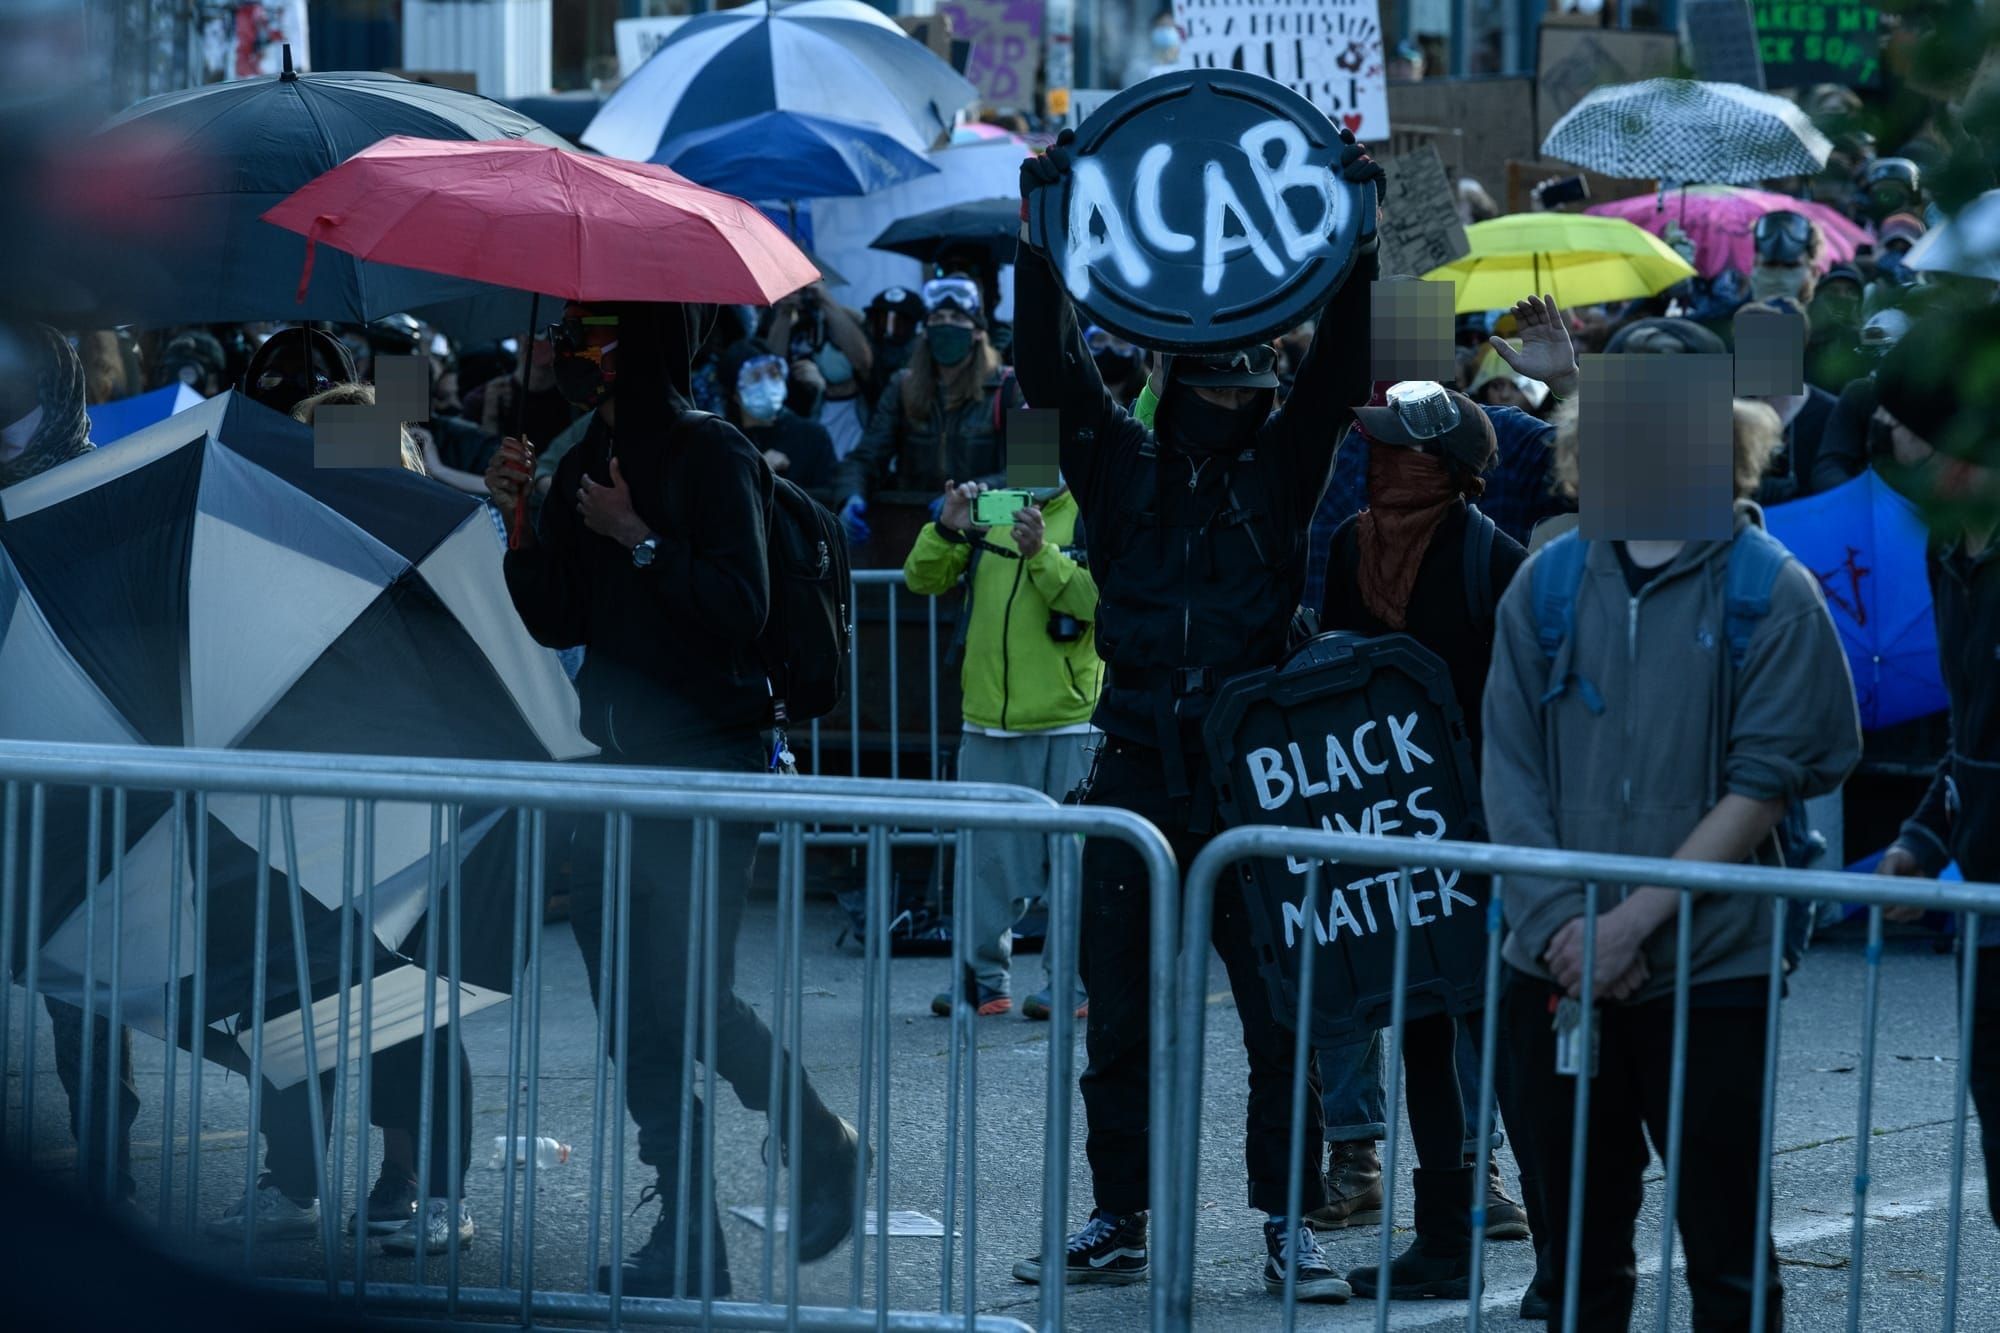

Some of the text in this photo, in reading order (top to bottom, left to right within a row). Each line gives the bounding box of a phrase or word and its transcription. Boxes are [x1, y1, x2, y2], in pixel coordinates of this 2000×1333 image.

[1756, 5, 1825, 31] AKES
[1760, 37, 1793, 64] CK
[1062, 119, 1352, 302] ACAB
[1246, 711, 1435, 811] BLACK
